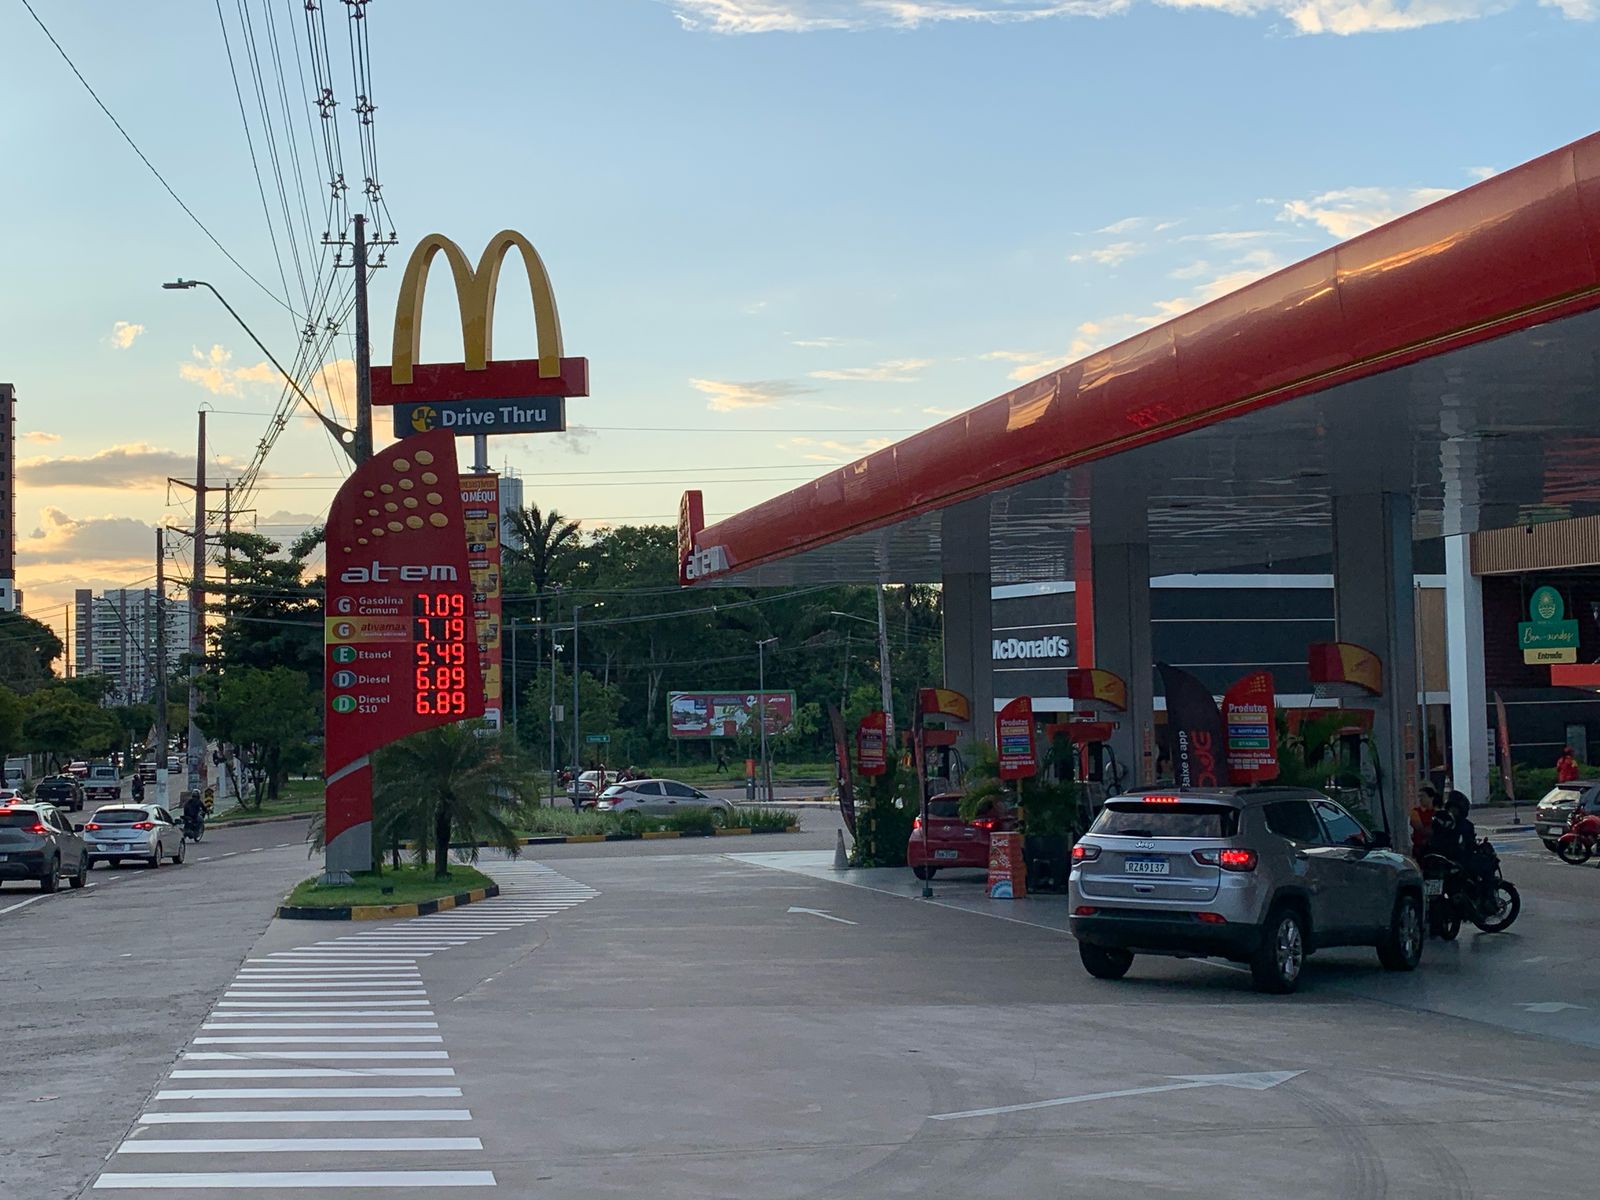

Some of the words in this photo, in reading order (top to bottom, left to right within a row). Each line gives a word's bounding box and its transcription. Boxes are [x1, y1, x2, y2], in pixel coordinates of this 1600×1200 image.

[442, 408, 495, 426] Drive
[500, 406, 546, 424] Thru
[340, 561, 458, 582] atem
[338, 599, 351, 613] G
[359, 596, 404, 605] Gasolina
[418, 594, 464, 616] 7.09
[358, 606, 398, 614] Comum
[338, 624, 350, 636] G
[418, 618, 464, 641] 7.19
[359, 650, 392, 659] Etanol
[416, 643, 464, 665] 5.49
[992, 636, 1069, 659] McDonald's
[340, 648, 349, 662] E
[338, 673, 350, 688] D
[359, 675, 390, 684] Diesel
[416, 667, 465, 690] 6.89
[340, 698, 350, 712] D
[359, 695, 390, 704] Diesel
[416, 692, 465, 714] 6.89
[359, 705, 378, 713] S10
[1228, 704, 1268, 712] Produtos
[1178, 730, 1189, 751] app
